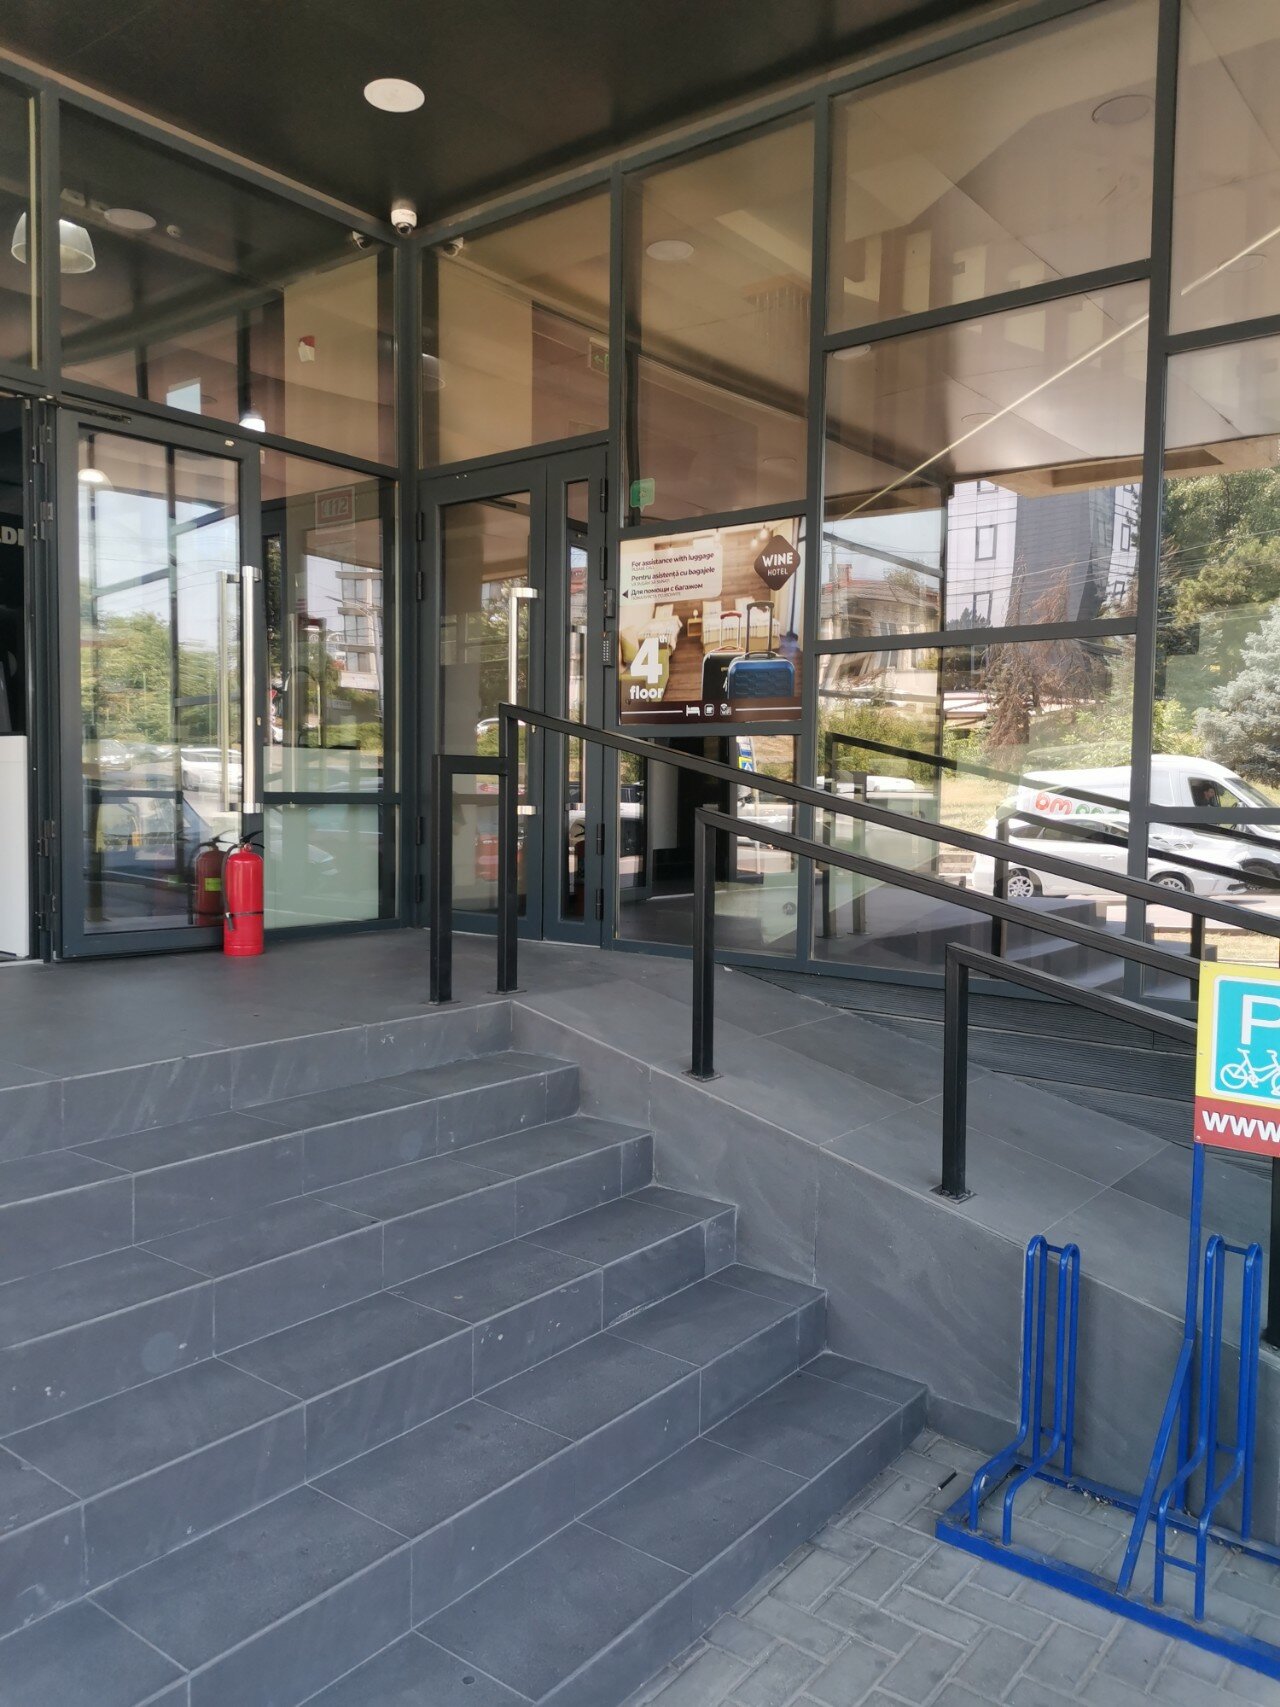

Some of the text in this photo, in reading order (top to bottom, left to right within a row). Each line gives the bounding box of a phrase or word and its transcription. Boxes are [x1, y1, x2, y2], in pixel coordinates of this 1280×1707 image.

[642, 558, 673, 567] assistance
[689, 552, 714, 561] luggage
[762, 552, 793, 567] WINE
[689, 567, 715, 576] bagajele
[768, 568, 789, 576] HOTEL
[675, 583, 703, 591] багажом
[630, 686, 664, 699] floor
[1241, 994, 1280, 1045] P
[1202, 1110, 1280, 1143] www
